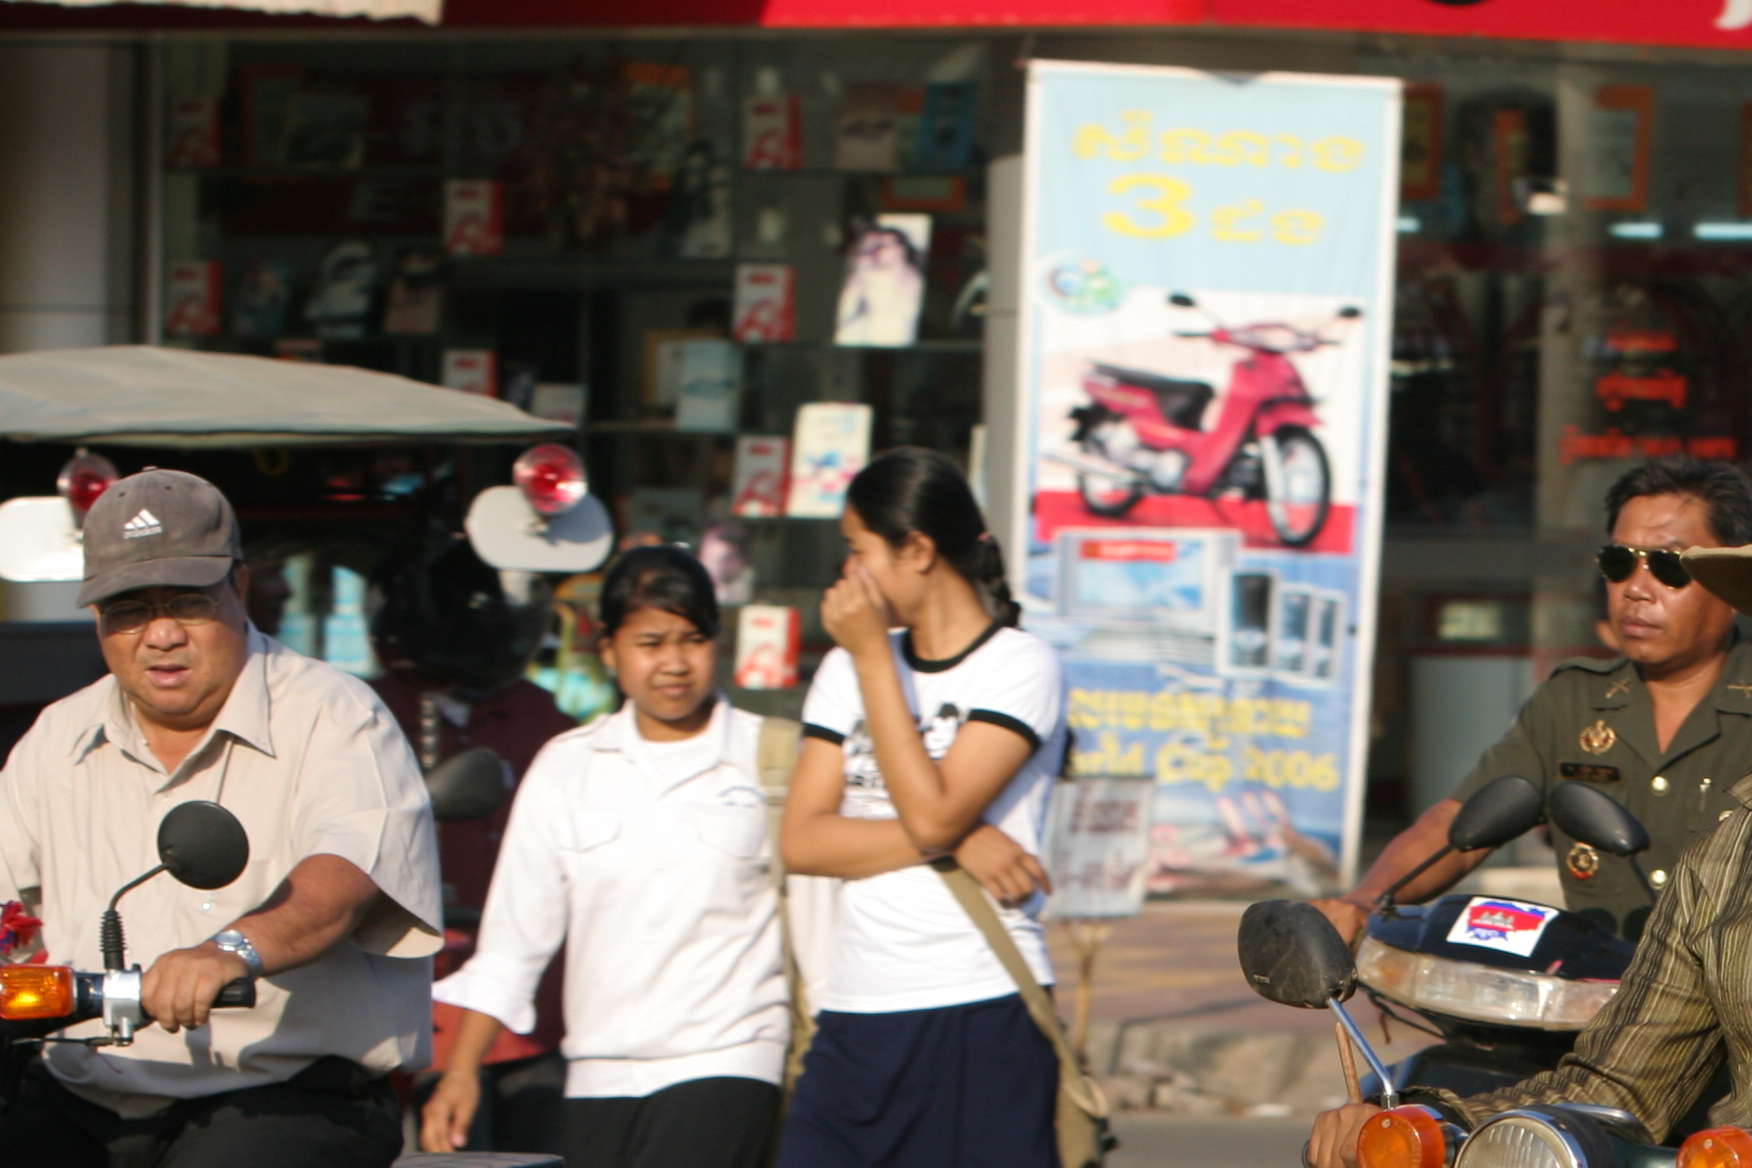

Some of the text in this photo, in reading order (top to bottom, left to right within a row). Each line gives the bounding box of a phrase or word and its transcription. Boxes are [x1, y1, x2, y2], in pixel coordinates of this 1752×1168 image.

[1103, 173, 1195, 239] 3
[1157, 744, 1232, 792] Cup
[1244, 748, 1340, 791] 2006
